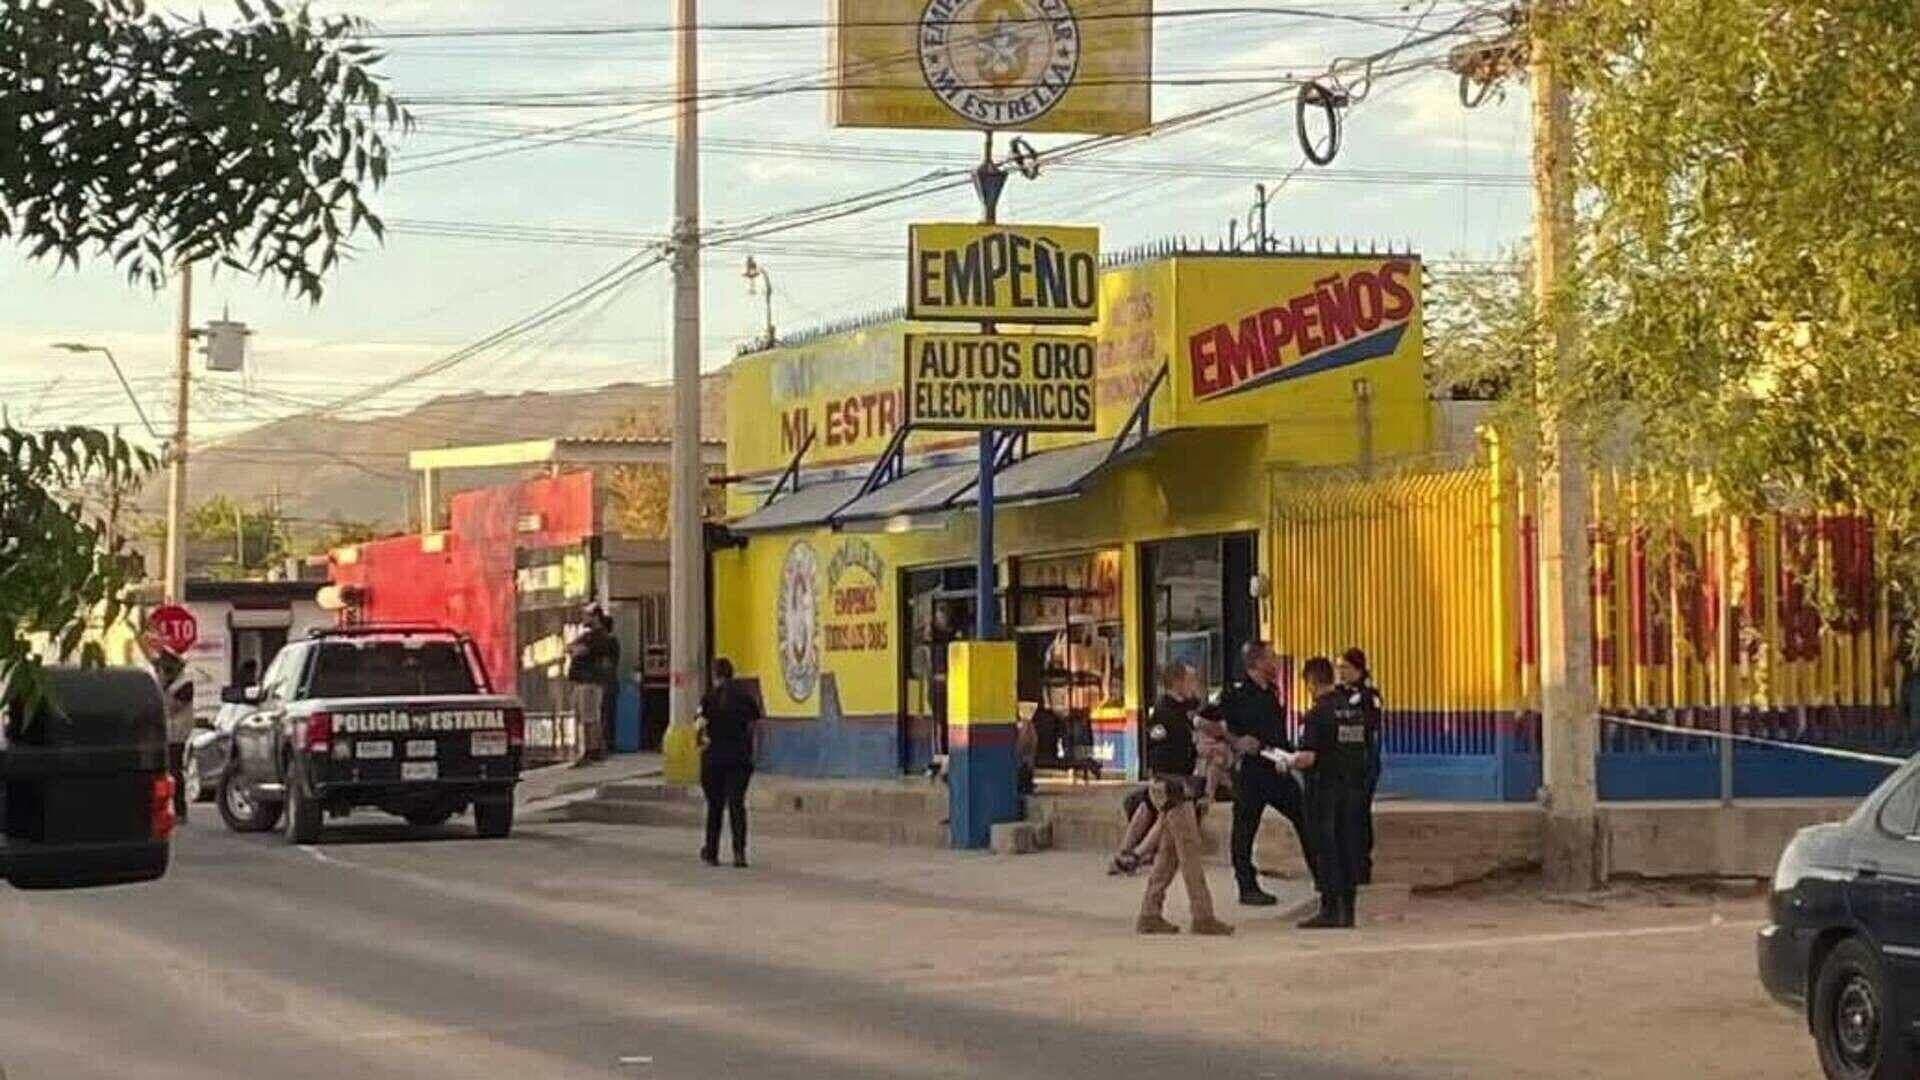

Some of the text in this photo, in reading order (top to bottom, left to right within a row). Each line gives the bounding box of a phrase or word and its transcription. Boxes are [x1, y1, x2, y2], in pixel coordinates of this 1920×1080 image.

[961, 64, 1071, 121] ESTRELLA
[919, 232, 1095, 309] EMPEÑO
[1189, 259, 1415, 398] EMPEÑOS
[919, 341, 1021, 379] AUTOS
[1033, 341, 1094, 380] ORO
[915, 381, 1090, 421] ELECTRONICOS
[430, 710, 505, 730] ESTATAL
